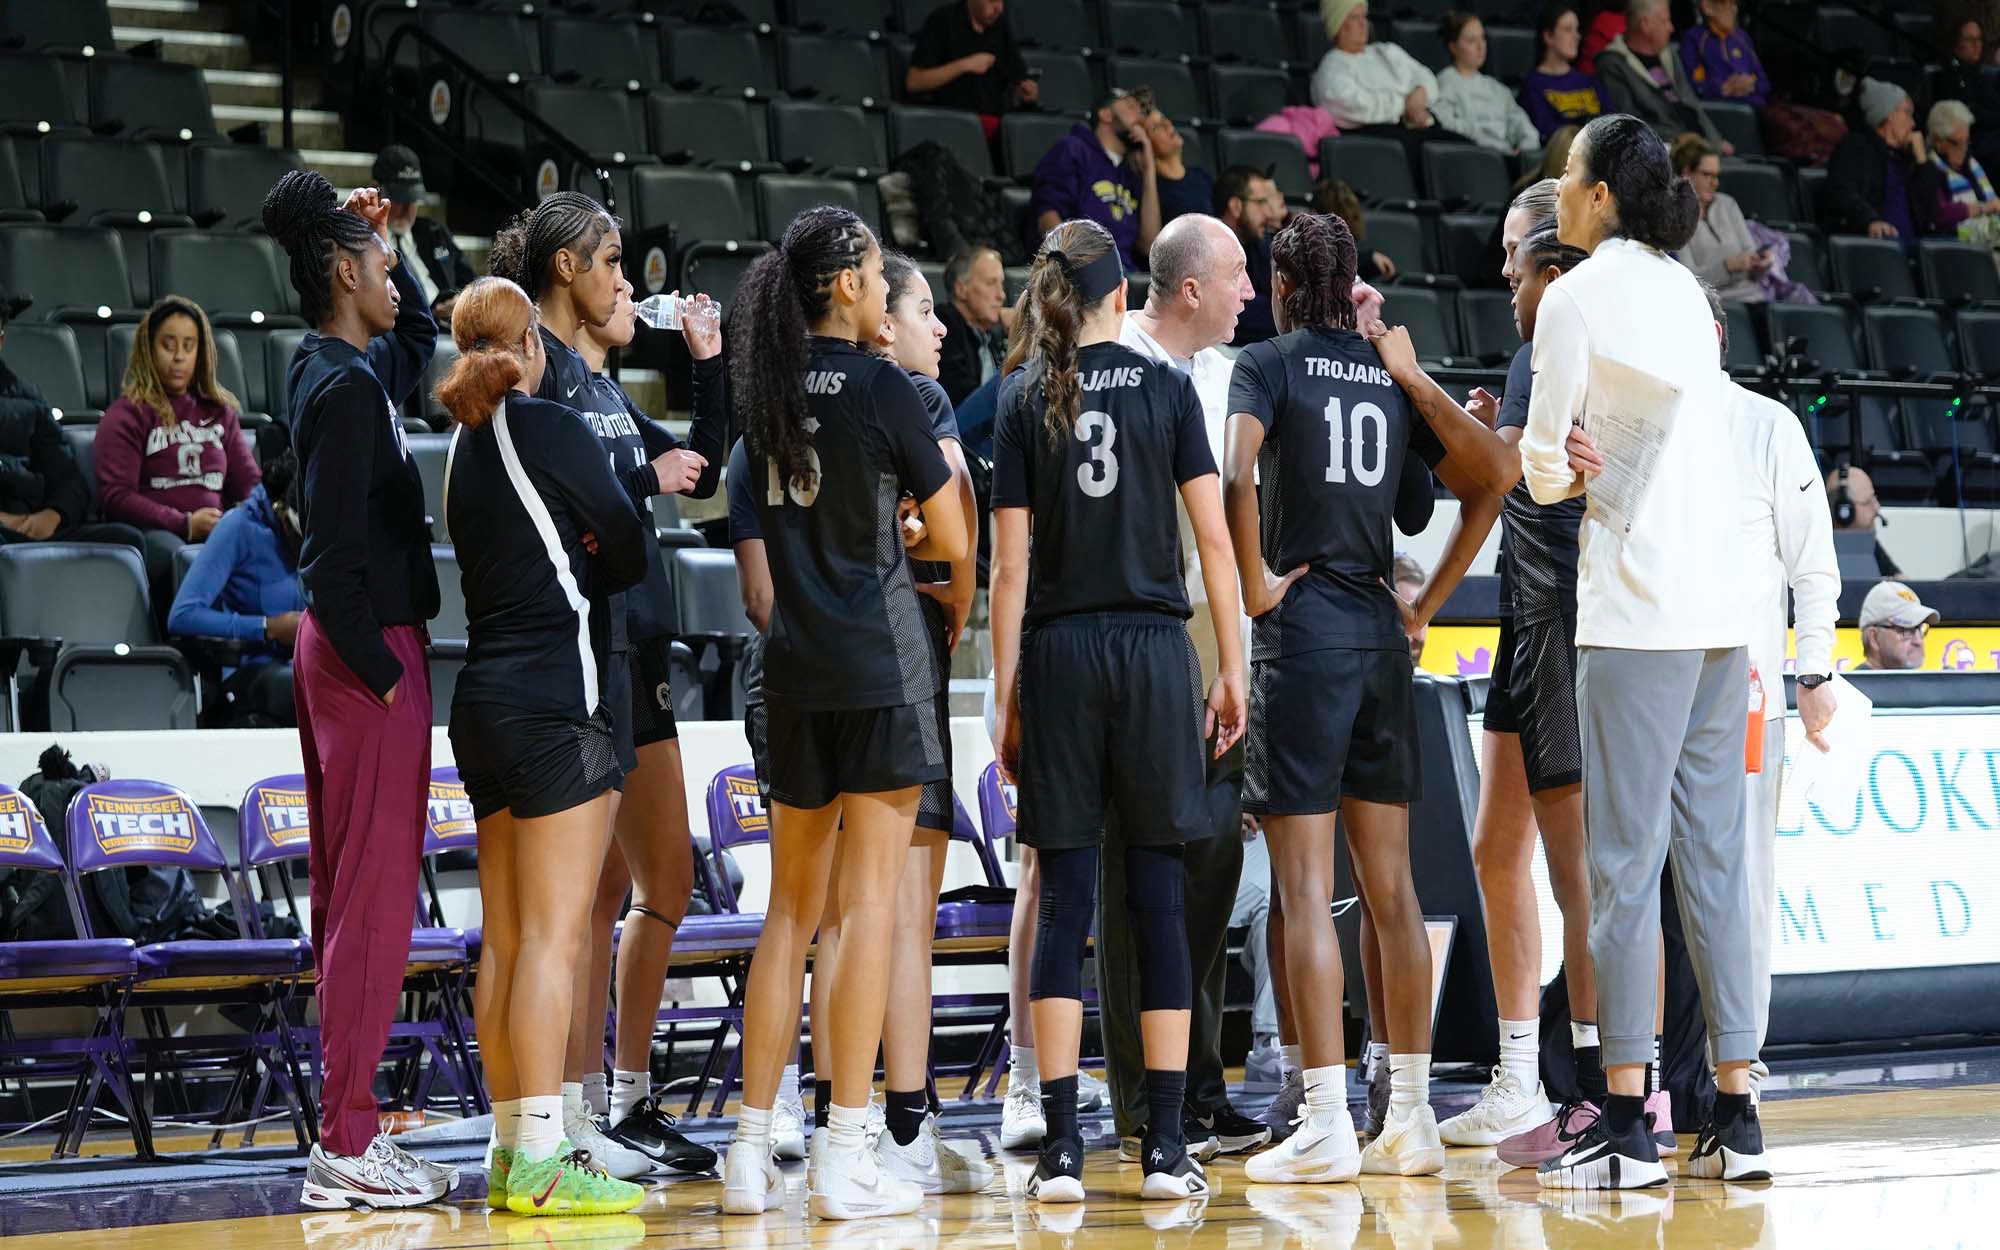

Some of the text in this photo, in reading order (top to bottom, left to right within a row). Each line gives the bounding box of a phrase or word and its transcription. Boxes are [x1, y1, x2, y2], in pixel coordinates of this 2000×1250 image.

[1305, 357, 1393, 387] TROJANS
[1075, 411, 1120, 498] 3
[1324, 396, 1388, 487] 10
[94, 799, 181, 813] TENNESSEE
[94, 812, 192, 839] TECH
